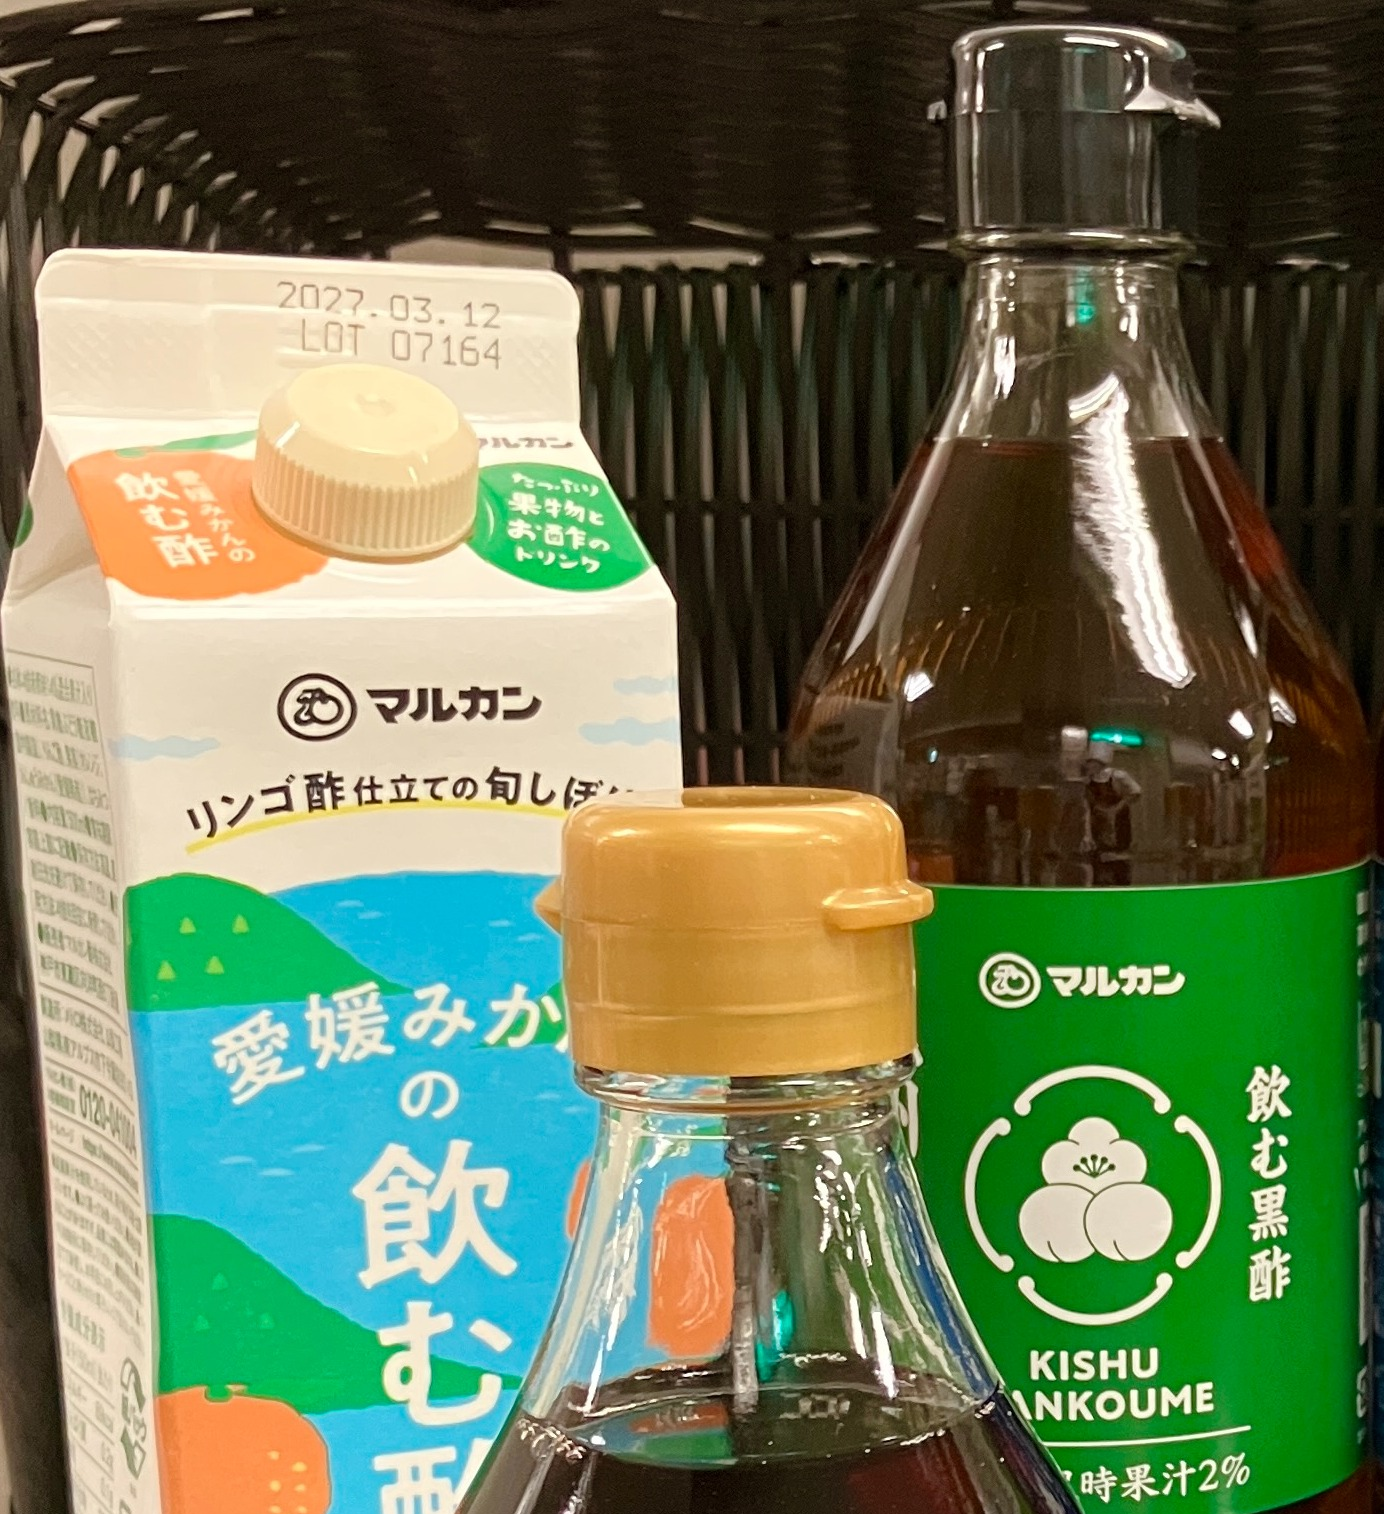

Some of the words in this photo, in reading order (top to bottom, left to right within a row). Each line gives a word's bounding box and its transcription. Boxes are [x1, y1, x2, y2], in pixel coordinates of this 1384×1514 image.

[277, 280, 502, 331] 2027.03.12
[300, 318, 366, 358] LOT
[390, 329, 502, 370] 07164
[114, 471, 220, 569] 飲む酢
[172, 469, 256, 563] みかんの
[507, 491, 606, 527] 果物と
[507, 518, 611, 552] お酢の
[514, 546, 601, 574] ドリンク
[366, 686, 544, 725] マルカン
[187, 764, 633, 839] リンゴ酢仕立ての旬しぼ
[1047, 963, 1187, 999] マルカン
[211, 981, 569, 1105] 愛媛みか
[1246, 1065, 1293, 1303] 飲む黒酢
[1029, 1347, 1159, 1382] KISHU
[1062, 1452, 1252, 1504] 時果汁2%
